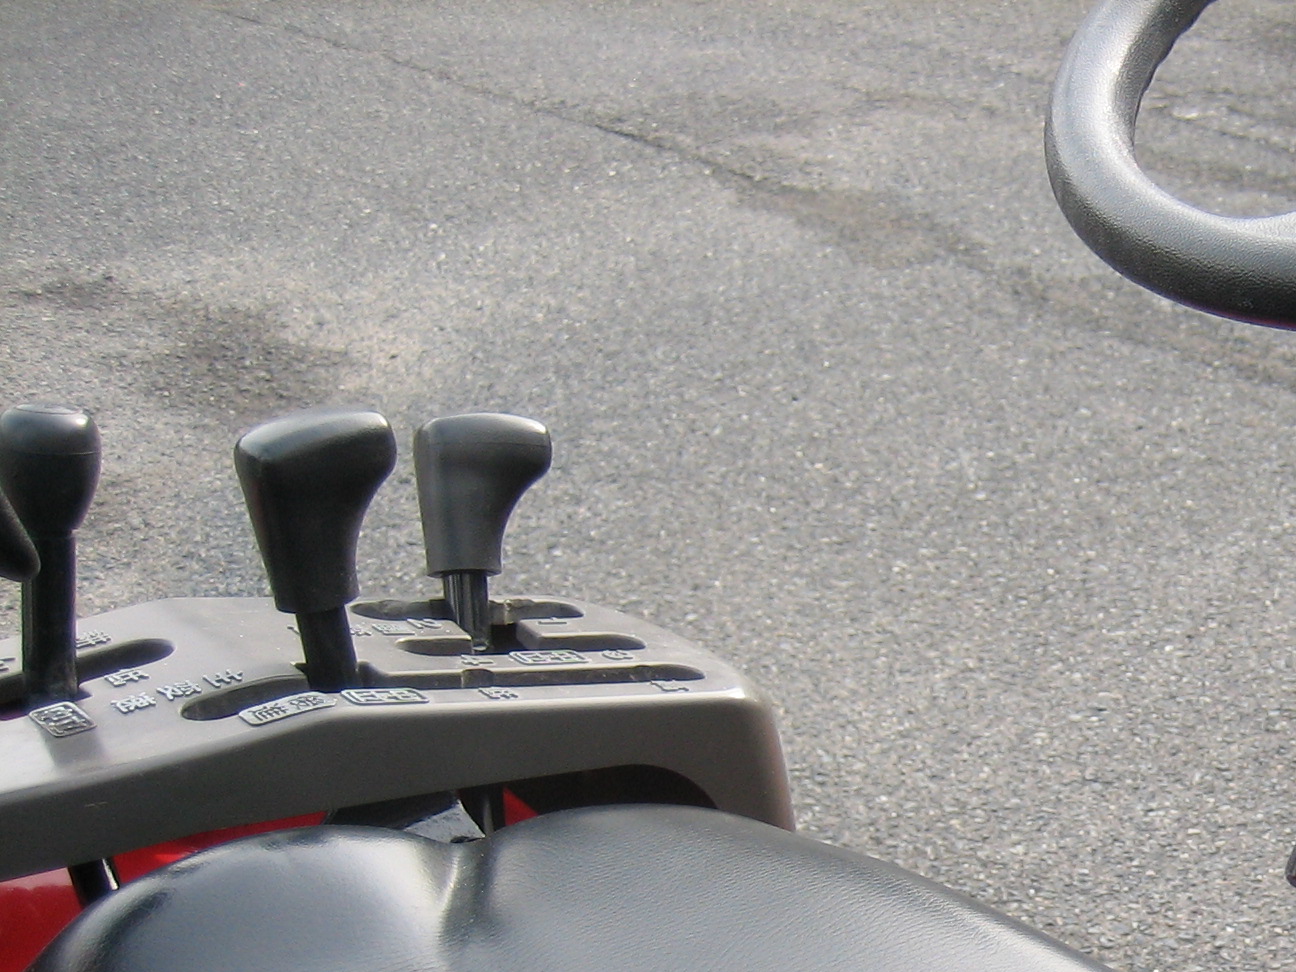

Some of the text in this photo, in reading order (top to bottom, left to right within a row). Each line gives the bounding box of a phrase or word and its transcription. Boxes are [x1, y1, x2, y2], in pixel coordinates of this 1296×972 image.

[406, 618, 442, 630] 2
[110, 667, 244, 714] 主変速
